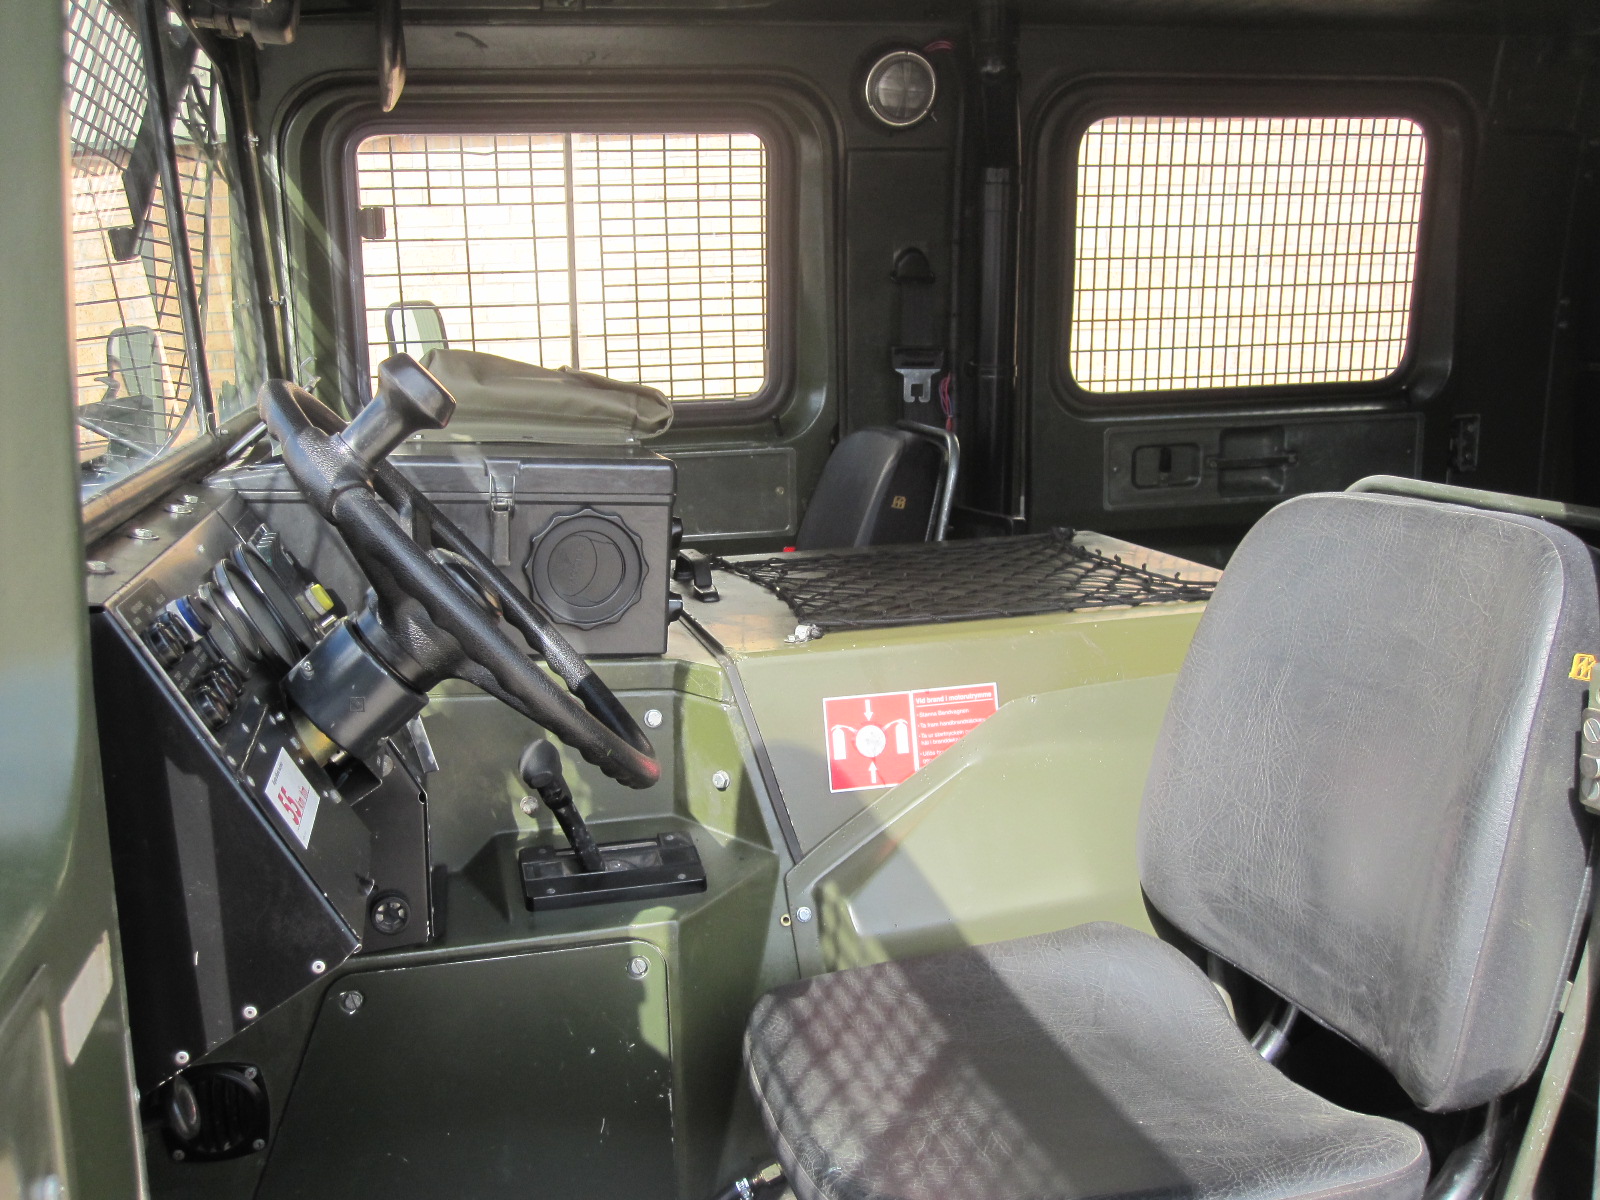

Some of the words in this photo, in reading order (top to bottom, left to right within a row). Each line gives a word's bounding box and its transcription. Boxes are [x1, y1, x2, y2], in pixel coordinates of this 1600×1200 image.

[927, 695, 944, 703] brand
[948, 692, 992, 701] motorutrymme
[277, 785, 302, 826] 55
